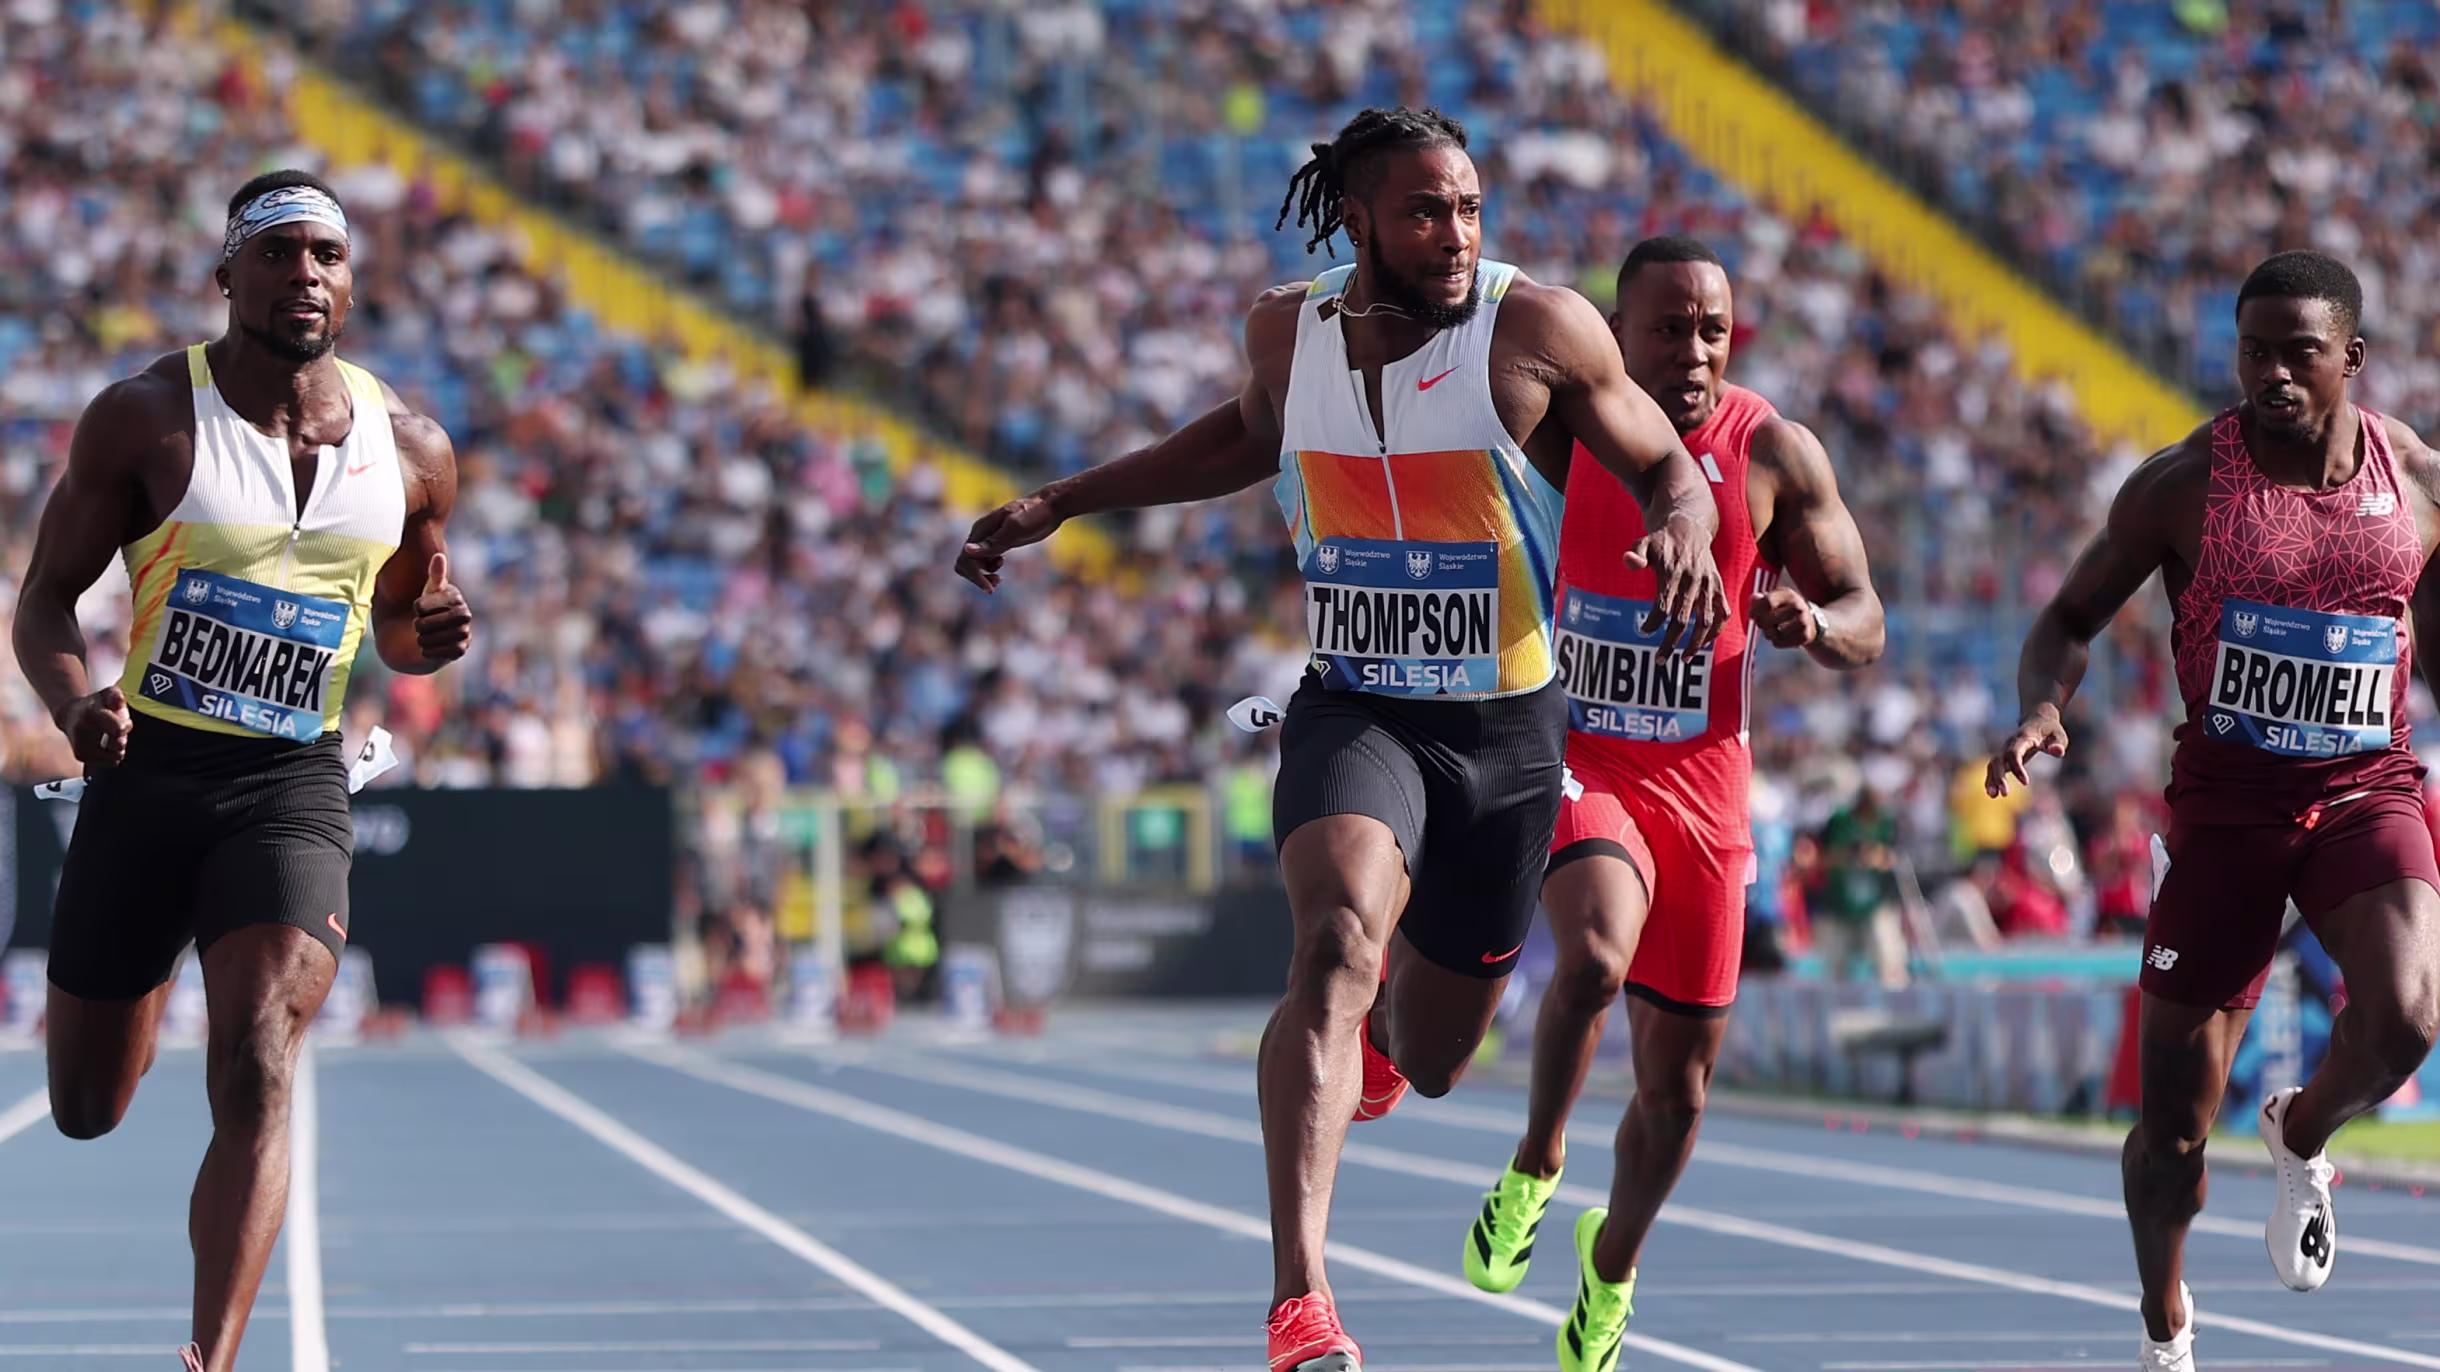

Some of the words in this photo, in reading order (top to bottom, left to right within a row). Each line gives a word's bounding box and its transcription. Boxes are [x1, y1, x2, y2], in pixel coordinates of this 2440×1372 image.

[1313, 587, 1490, 656] THOMPSON
[159, 610, 332, 712] BEDNAREK
[1363, 664, 1470, 687] SILESIA
[1558, 635, 1706, 709] SIMBINE
[2218, 647, 2384, 726] BROMELL
[199, 694, 296, 737] SILESIA
[1251, 707, 1280, 727] 5
[1586, 708, 1681, 737] SILESIA
[2265, 725, 2363, 754] SILESIA
